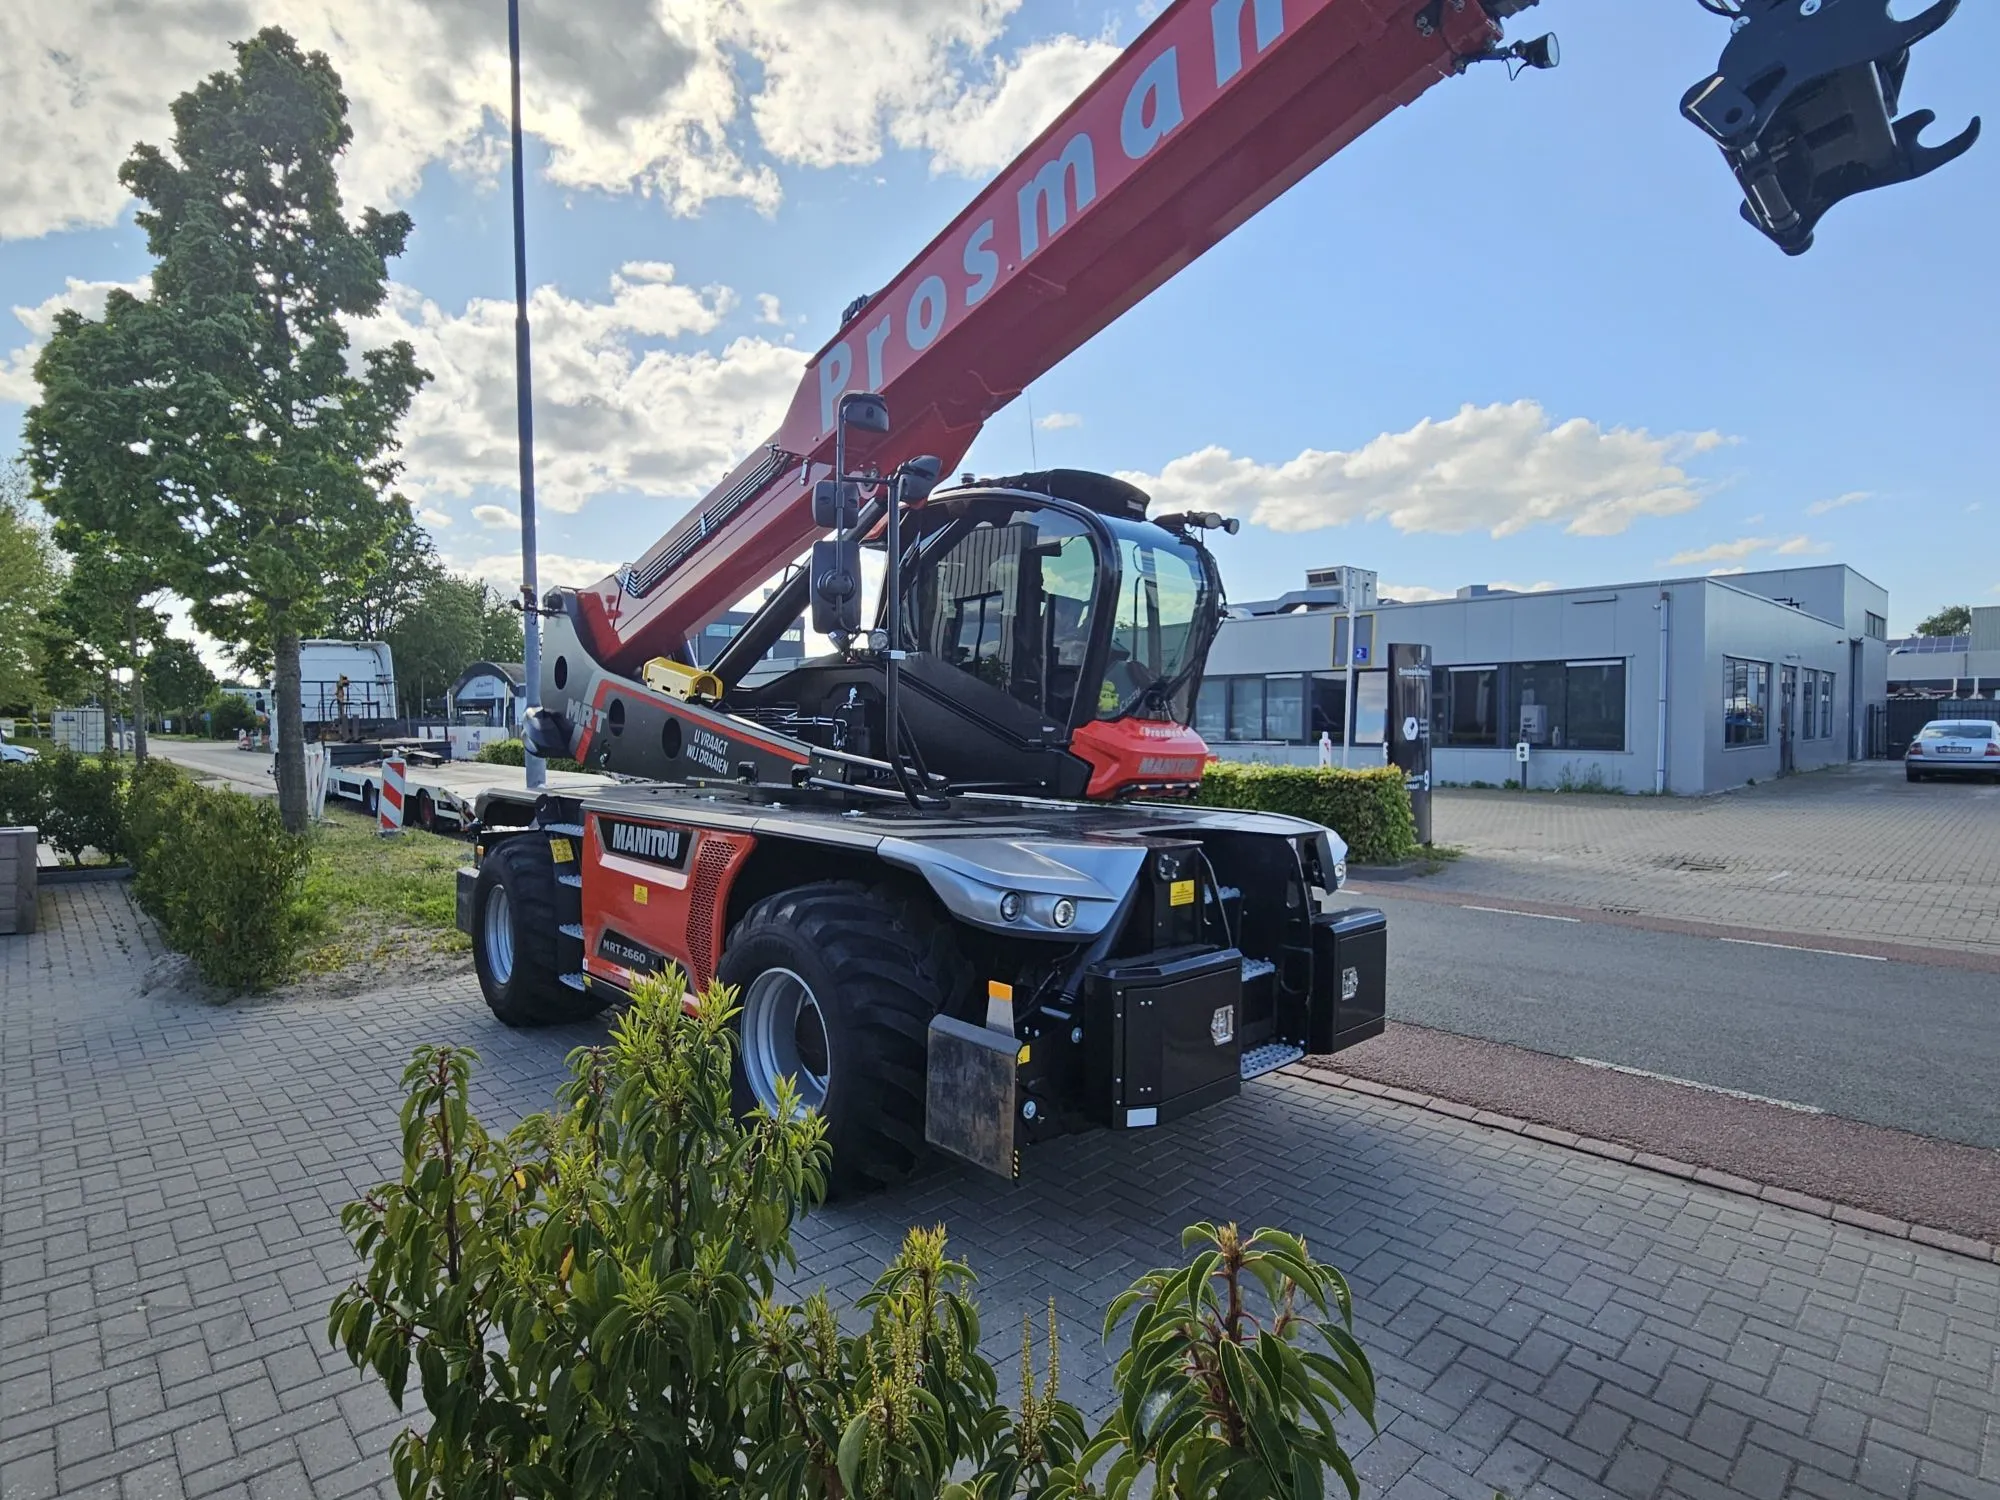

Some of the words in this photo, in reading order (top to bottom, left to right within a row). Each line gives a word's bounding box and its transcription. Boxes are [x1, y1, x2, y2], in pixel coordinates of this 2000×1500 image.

[819, 0, 1284, 434] Prosman
[566, 698, 607, 733] MRT
[694, 729, 701, 743] U
[700, 731, 729, 755] VRAAGT
[686, 743, 700, 761] WIJ
[698, 748, 729, 775] DRAAIEN
[1424, 770, 1430, 791] 9
[612, 823, 680, 860] MANITOU
[602, 939, 622, 955] MRT
[622, 946, 646, 964] 2660
